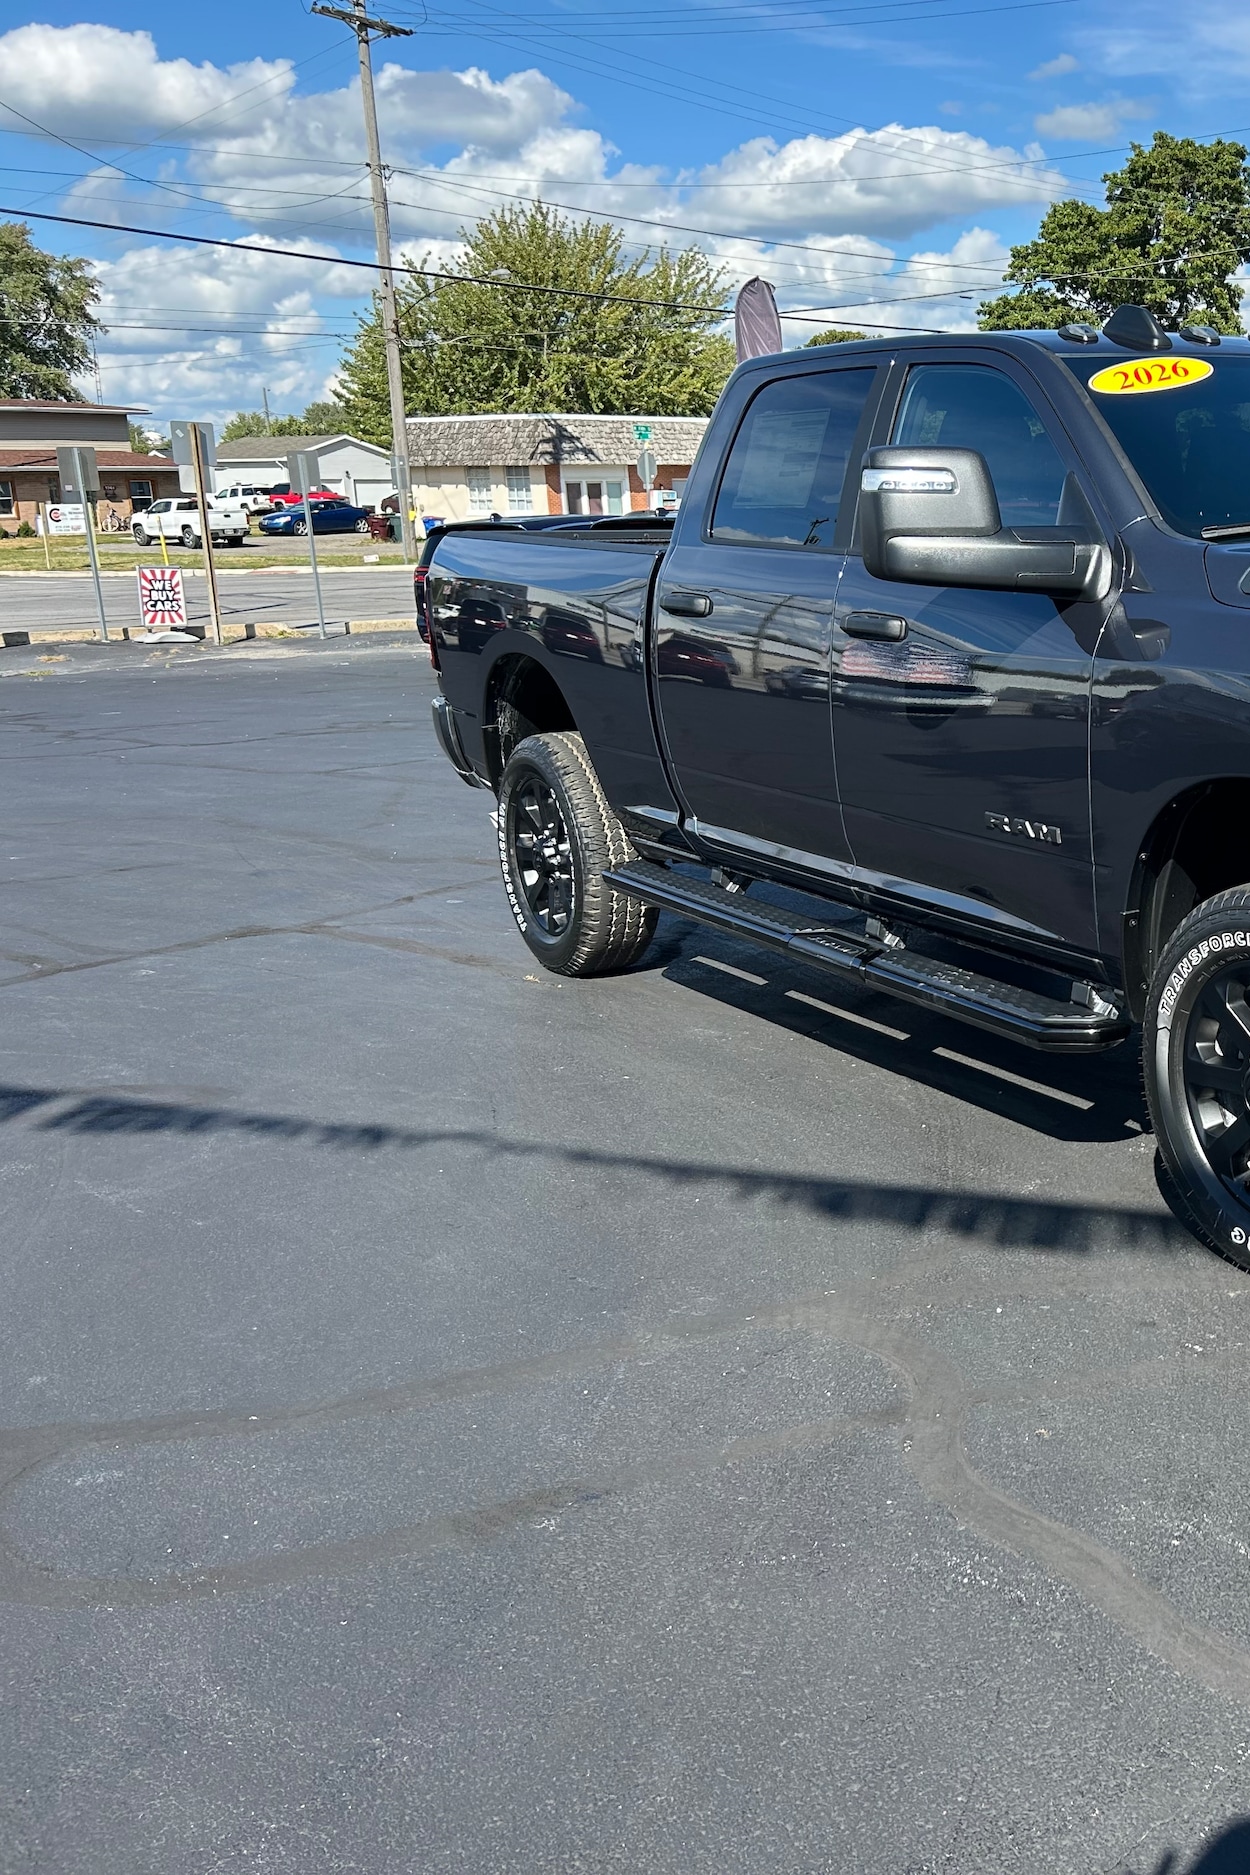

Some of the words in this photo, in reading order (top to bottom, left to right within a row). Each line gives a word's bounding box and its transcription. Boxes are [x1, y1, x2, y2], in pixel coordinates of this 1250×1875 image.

[1113, 360, 1189, 390] 2026
[150, 580, 172, 590] WE
[150, 590, 175, 601] BUY
[146, 600, 180, 611] CARS
